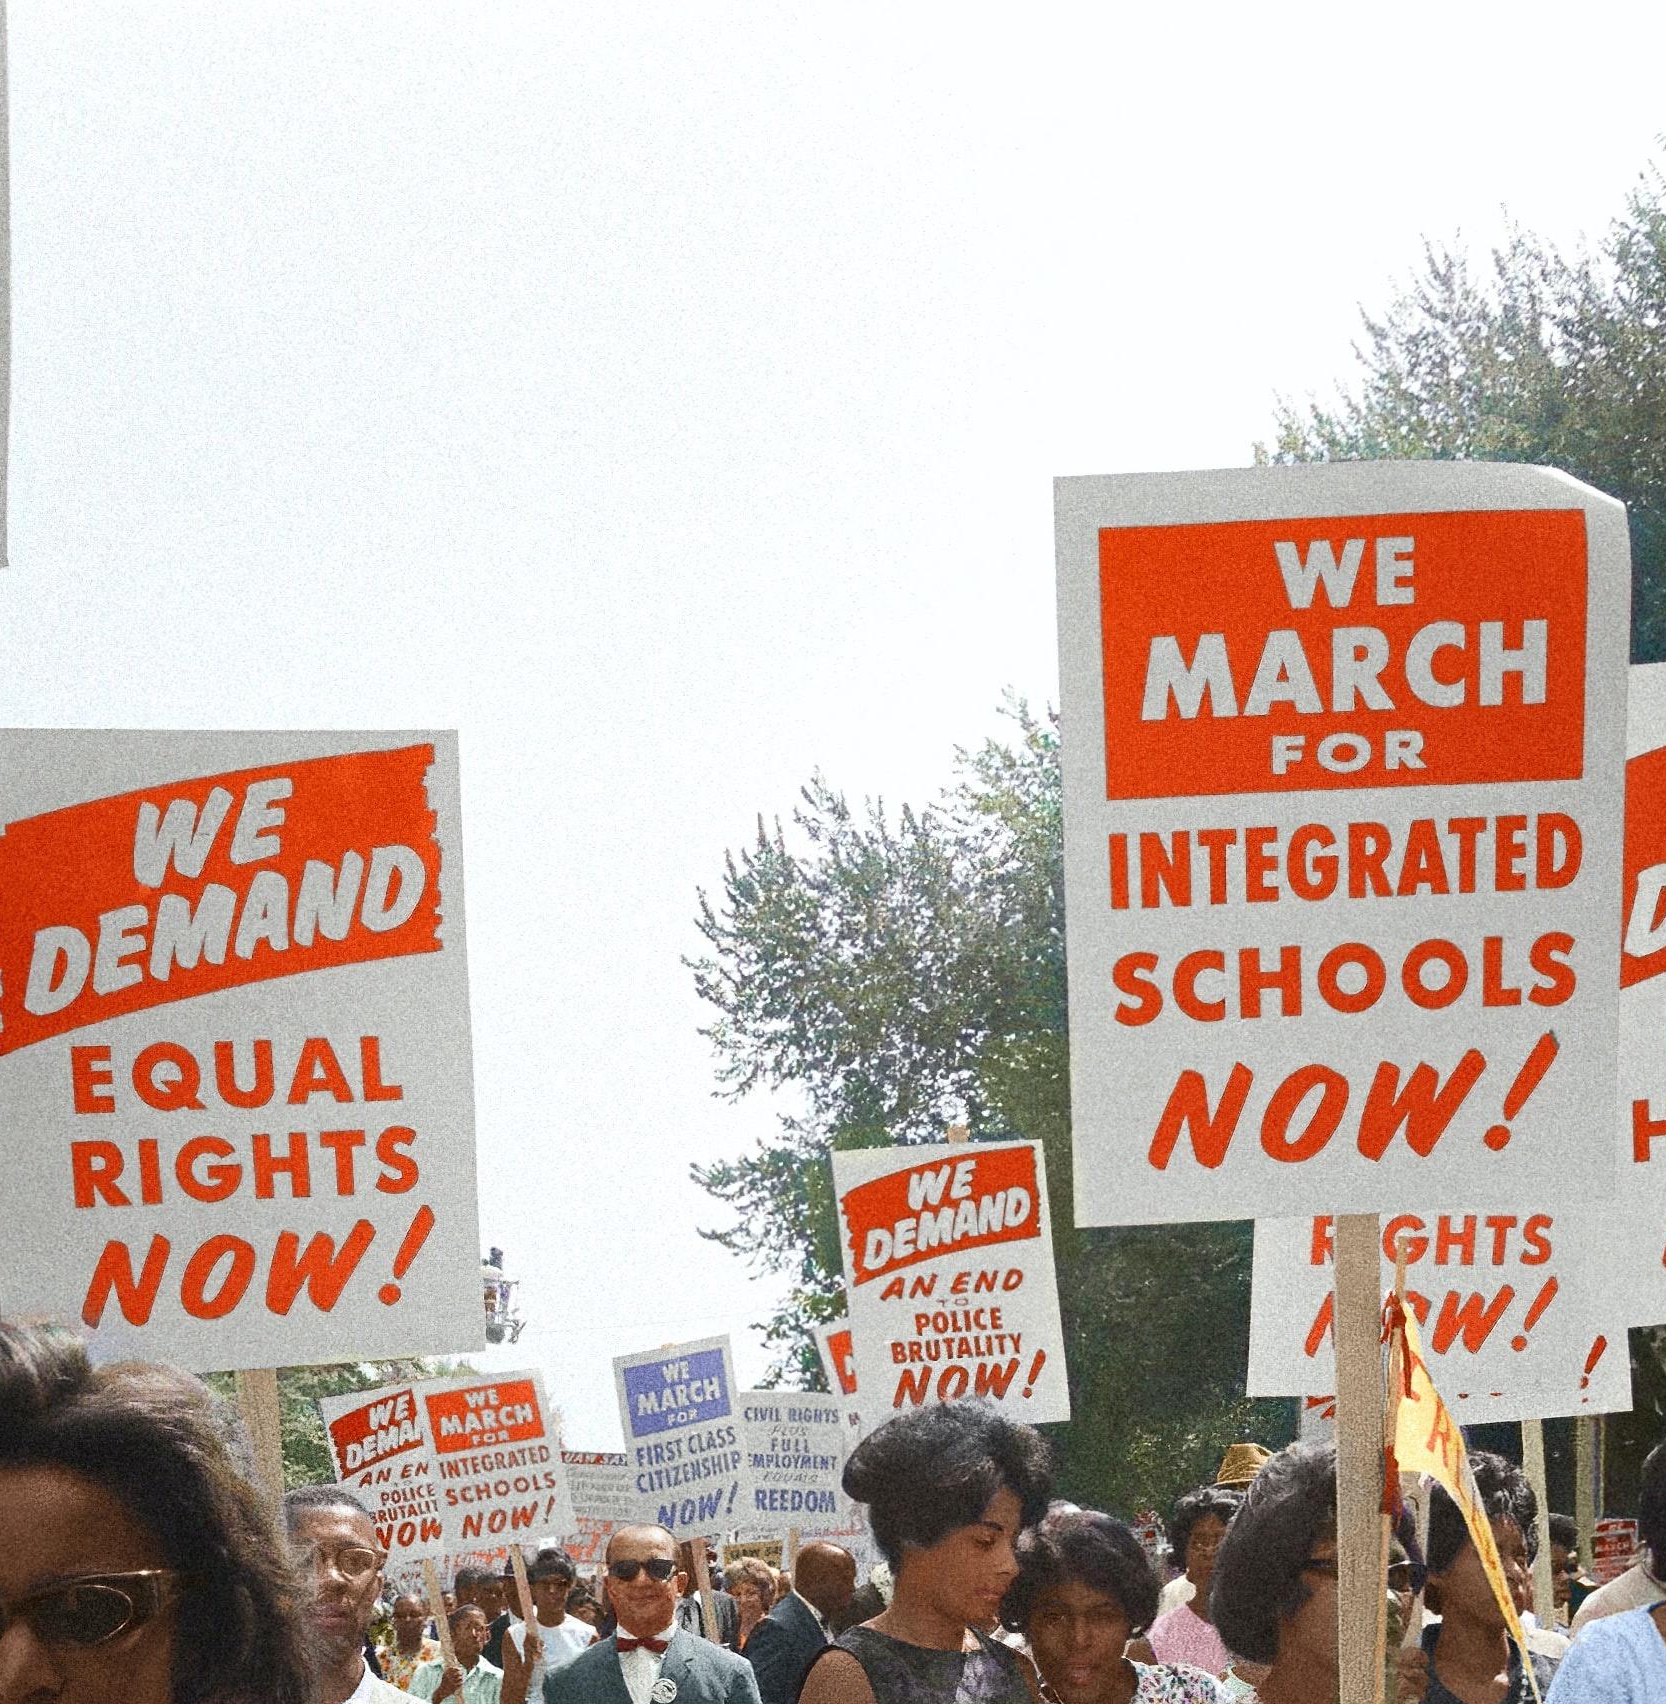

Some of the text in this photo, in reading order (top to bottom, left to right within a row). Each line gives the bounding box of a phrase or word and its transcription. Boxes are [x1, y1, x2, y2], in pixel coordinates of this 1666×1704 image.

[1273, 535, 1417, 609] WE
[1141, 619, 1549, 723] MARCH
[1271, 729, 1427, 775] FOR
[133, 777, 294, 889] WE
[1108, 811, 1582, 909] INTEGRATED
[24, 844, 427, 1017] DEMAND
[1112, 932, 1577, 1028] SCHOOLS
[71, 1034, 403, 1115] EQUAL
[1148, 1030, 1560, 1172] NOW!
[72, 1125, 421, 1208] RIGHTS
[908, 1160, 976, 1211] WE
[862, 1187, 1031, 1271] DEMAND
[1310, 1213, 1554, 1266] RGHTS
[83, 1204, 436, 1328] NOW!
[880, 1268, 1025, 1301] AN END
[915, 1306, 1003, 1336] POLICE
[891, 1332, 1022, 1364] BRUTALITY
[662, 1361, 689, 1383] WE
[892, 1349, 1046, 1409] NOW!
[369, 1394, 410, 1430] WE
[465, 1389, 500, 1408] WE
[637, 1376, 722, 1416] MARCH
[744, 1407, 782, 1422] CIVIL
[788, 1408, 839, 1424] RIGHTS
[440, 1403, 533, 1437] MARCH
[472, 1430, 509, 1445] FOR
[668, 1409, 699, 1426] FOR
[345, 1419, 424, 1469] DEMA
[439, 1445, 550, 1480] INTEGRATED
[636, 1426, 737, 1467] FIRST CLASS
[771, 1438, 809, 1453] FULL
[359, 1467, 392, 1488] AN
[401, 1461, 429, 1479] EN
[445, 1471, 556, 1506] SCHOOLS
[636, 1451, 741, 1493] CITIZENSHIP
[380, 1482, 435, 1507] POLICE
[658, 1481, 738, 1529] NOW!
[754, 1489, 837, 1513] REEDOM
[462, 1495, 556, 1540] NOW!
